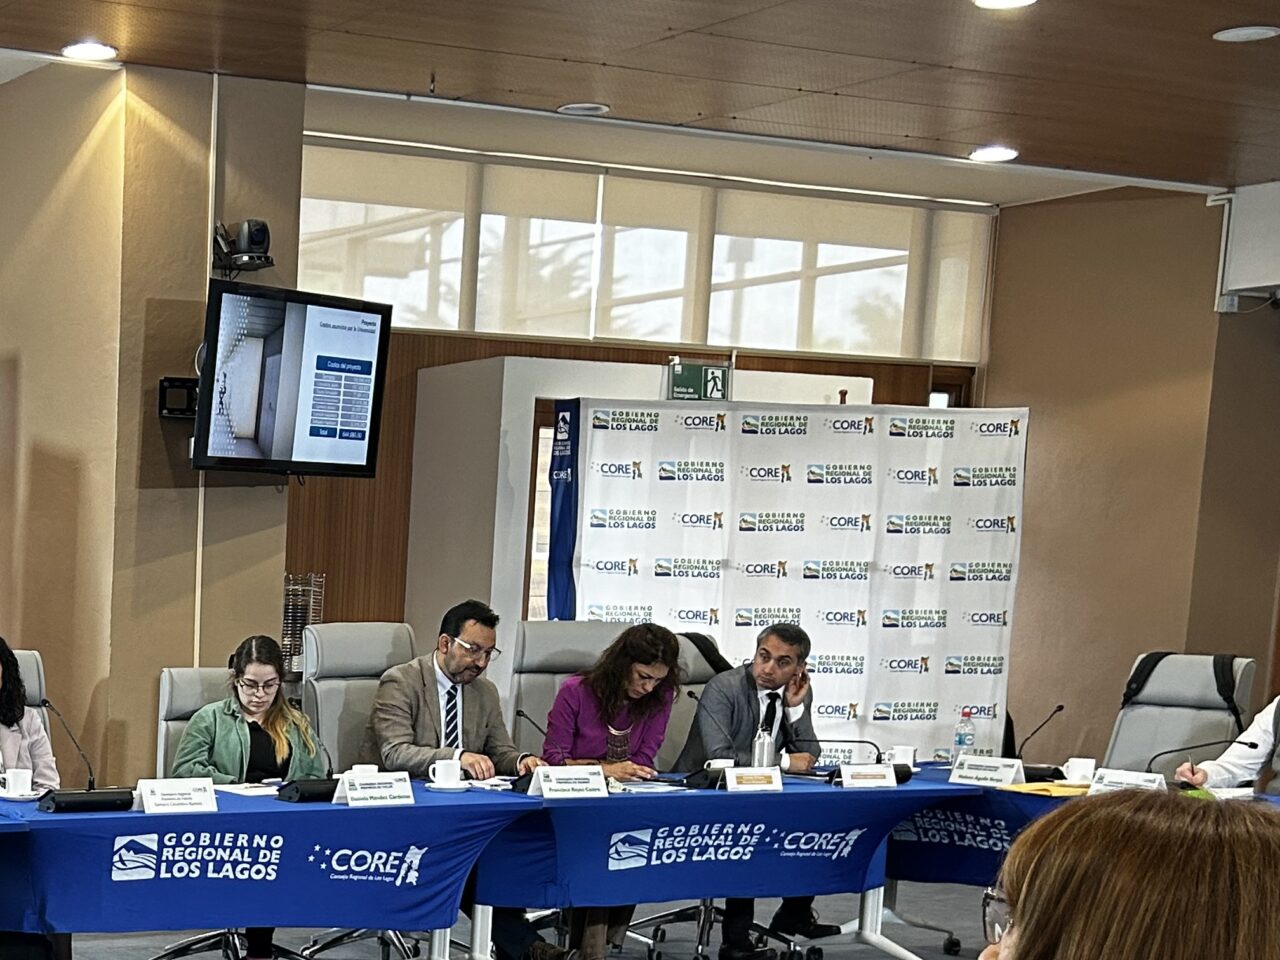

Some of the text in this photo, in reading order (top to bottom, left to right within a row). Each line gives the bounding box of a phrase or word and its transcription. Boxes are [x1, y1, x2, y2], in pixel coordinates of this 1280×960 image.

[611, 423, 626, 431] LOS
[684, 416, 715, 427] CORE
[832, 420, 863, 430] CORE
[979, 423, 1008, 433] CORE
[601, 463, 631, 474] CORE
[750, 467, 780, 478] CORE
[897, 470, 926, 481] CORE
[681, 514, 712, 525] CORE
[830, 516, 860, 527] CORE
[975, 518, 1006, 529] CORE
[596, 560, 627, 571] CORE
[746, 563, 777, 574] CORE
[893, 566, 923, 576] CORE
[678, 610, 708, 620] CORE
[826, 612, 856, 622] CORE
[971, 613, 1002, 623] CORE
[889, 659, 920, 670] CORE
[835, 667, 864, 675] LAGOS
[817, 705, 847, 716] CORE
[657, 824, 765, 837] GOBIERNO
[919, 829, 950, 843] LOS
[163, 833, 283, 849] GOBIERNO
[653, 835, 760, 849] REGIONAL DE
[784, 832, 846, 850] CORE
[162, 848, 281, 863] REGIONAL DE
[331, 849, 403, 873] CORE
[650, 847, 753, 865] LOS LAGOS
[160, 862, 278, 881] LOS LAGOS
